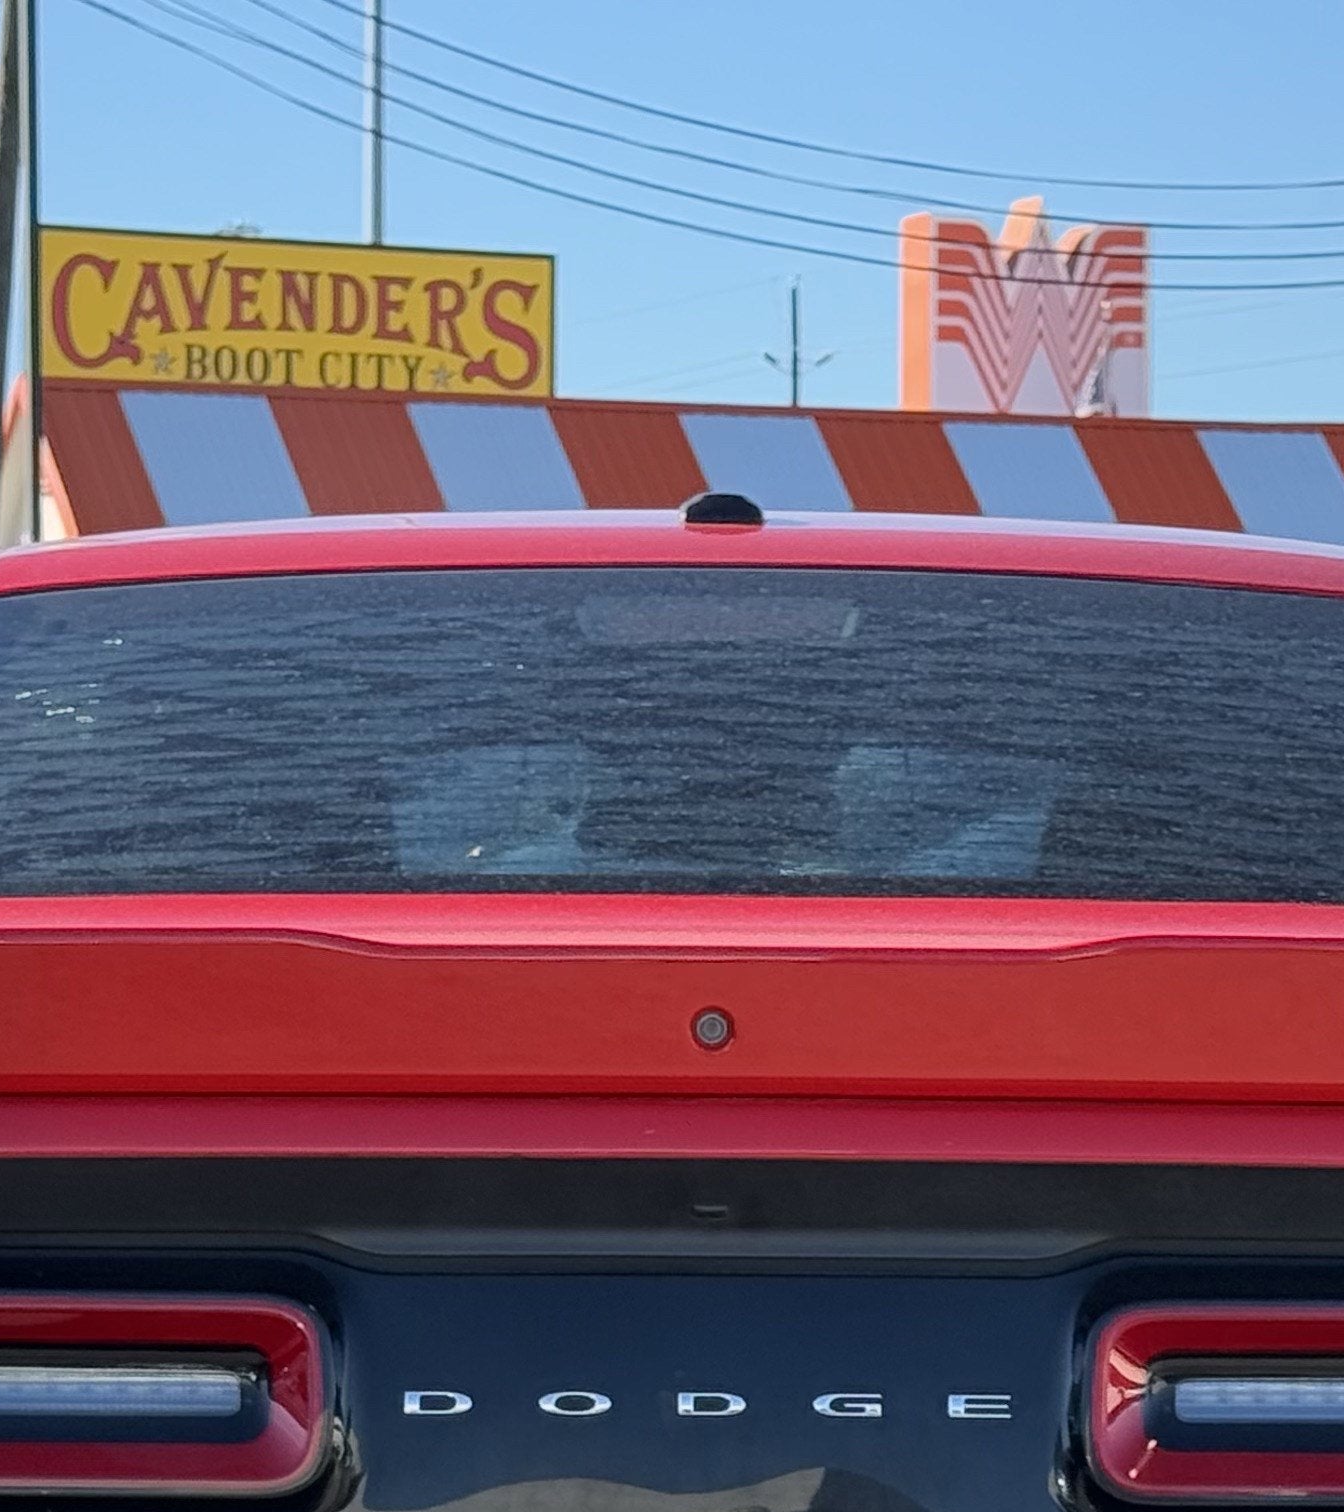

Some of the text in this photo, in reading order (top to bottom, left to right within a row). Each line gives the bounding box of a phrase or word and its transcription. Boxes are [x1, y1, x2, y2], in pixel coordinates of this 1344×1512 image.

[52, 250, 541, 391] CAVENDER'S
[183, 343, 424, 391] BOOT CITY
[403, 1390, 1013, 1419] DODGE
